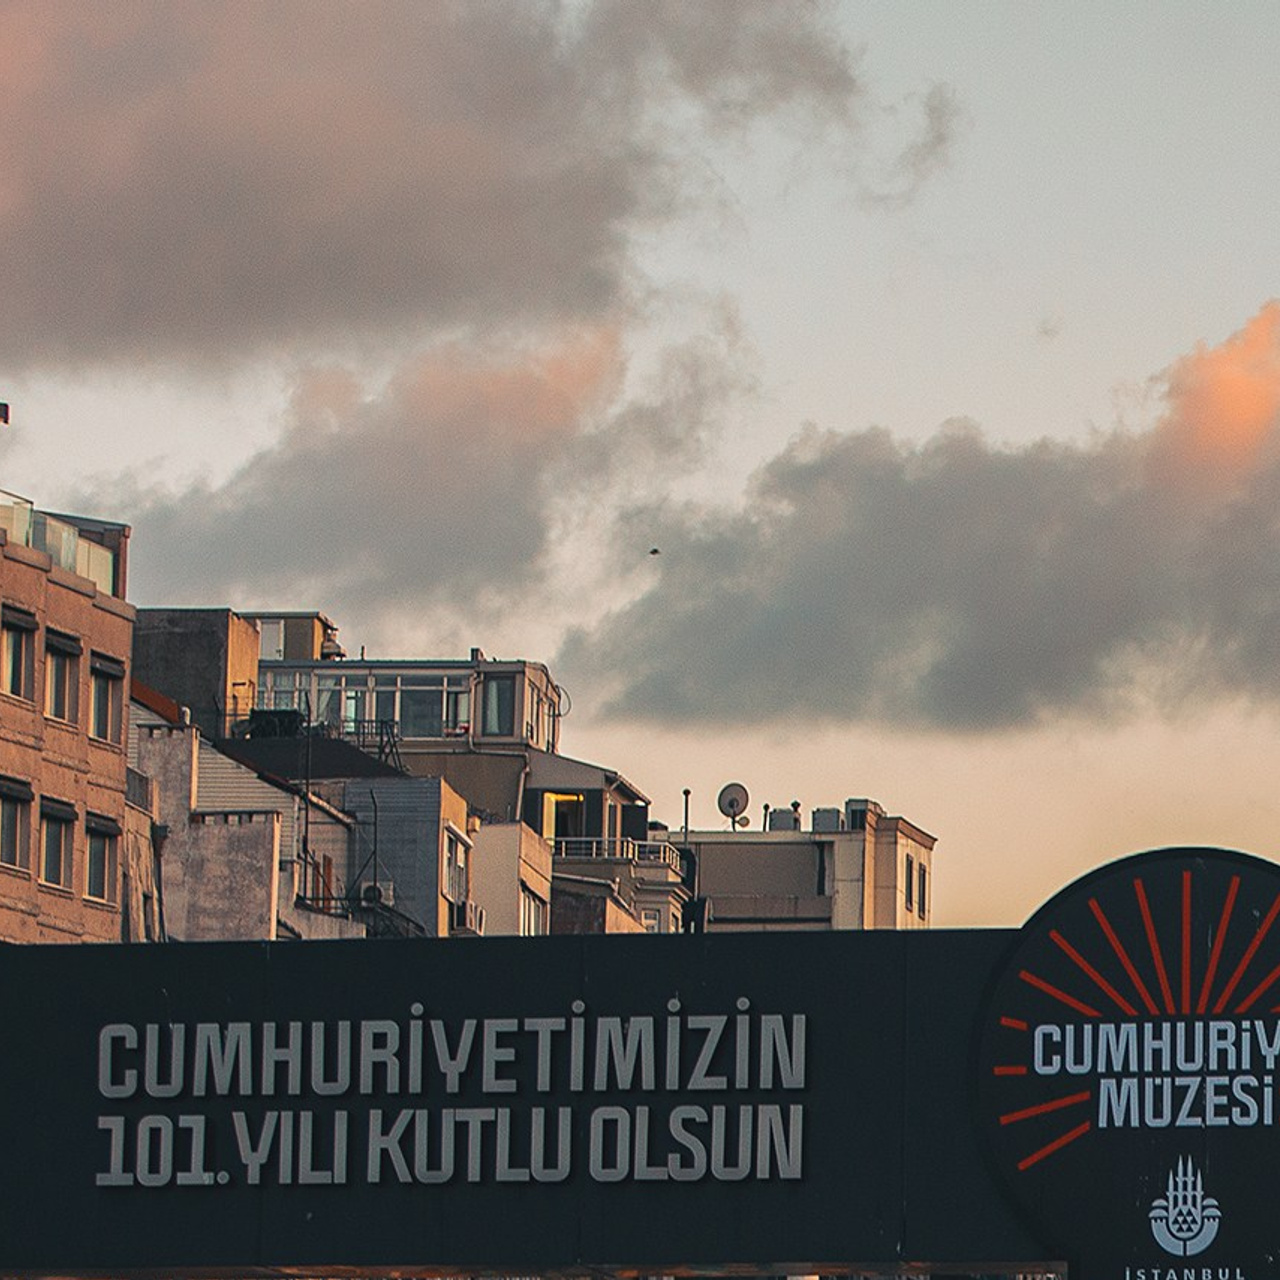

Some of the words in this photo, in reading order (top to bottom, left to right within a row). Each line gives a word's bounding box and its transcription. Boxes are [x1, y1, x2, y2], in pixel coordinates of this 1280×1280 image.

[98, 996, 806, 1097] CUMHURİYETİMİZİN
[1098, 1075, 1275, 1128] MÜZESİ
[96, 1114, 230, 1186] 101.
[232, 1110, 348, 1185] YILI
[367, 1106, 572, 1183] KUTLU
[589, 1104, 803, 1182] OLSUN
